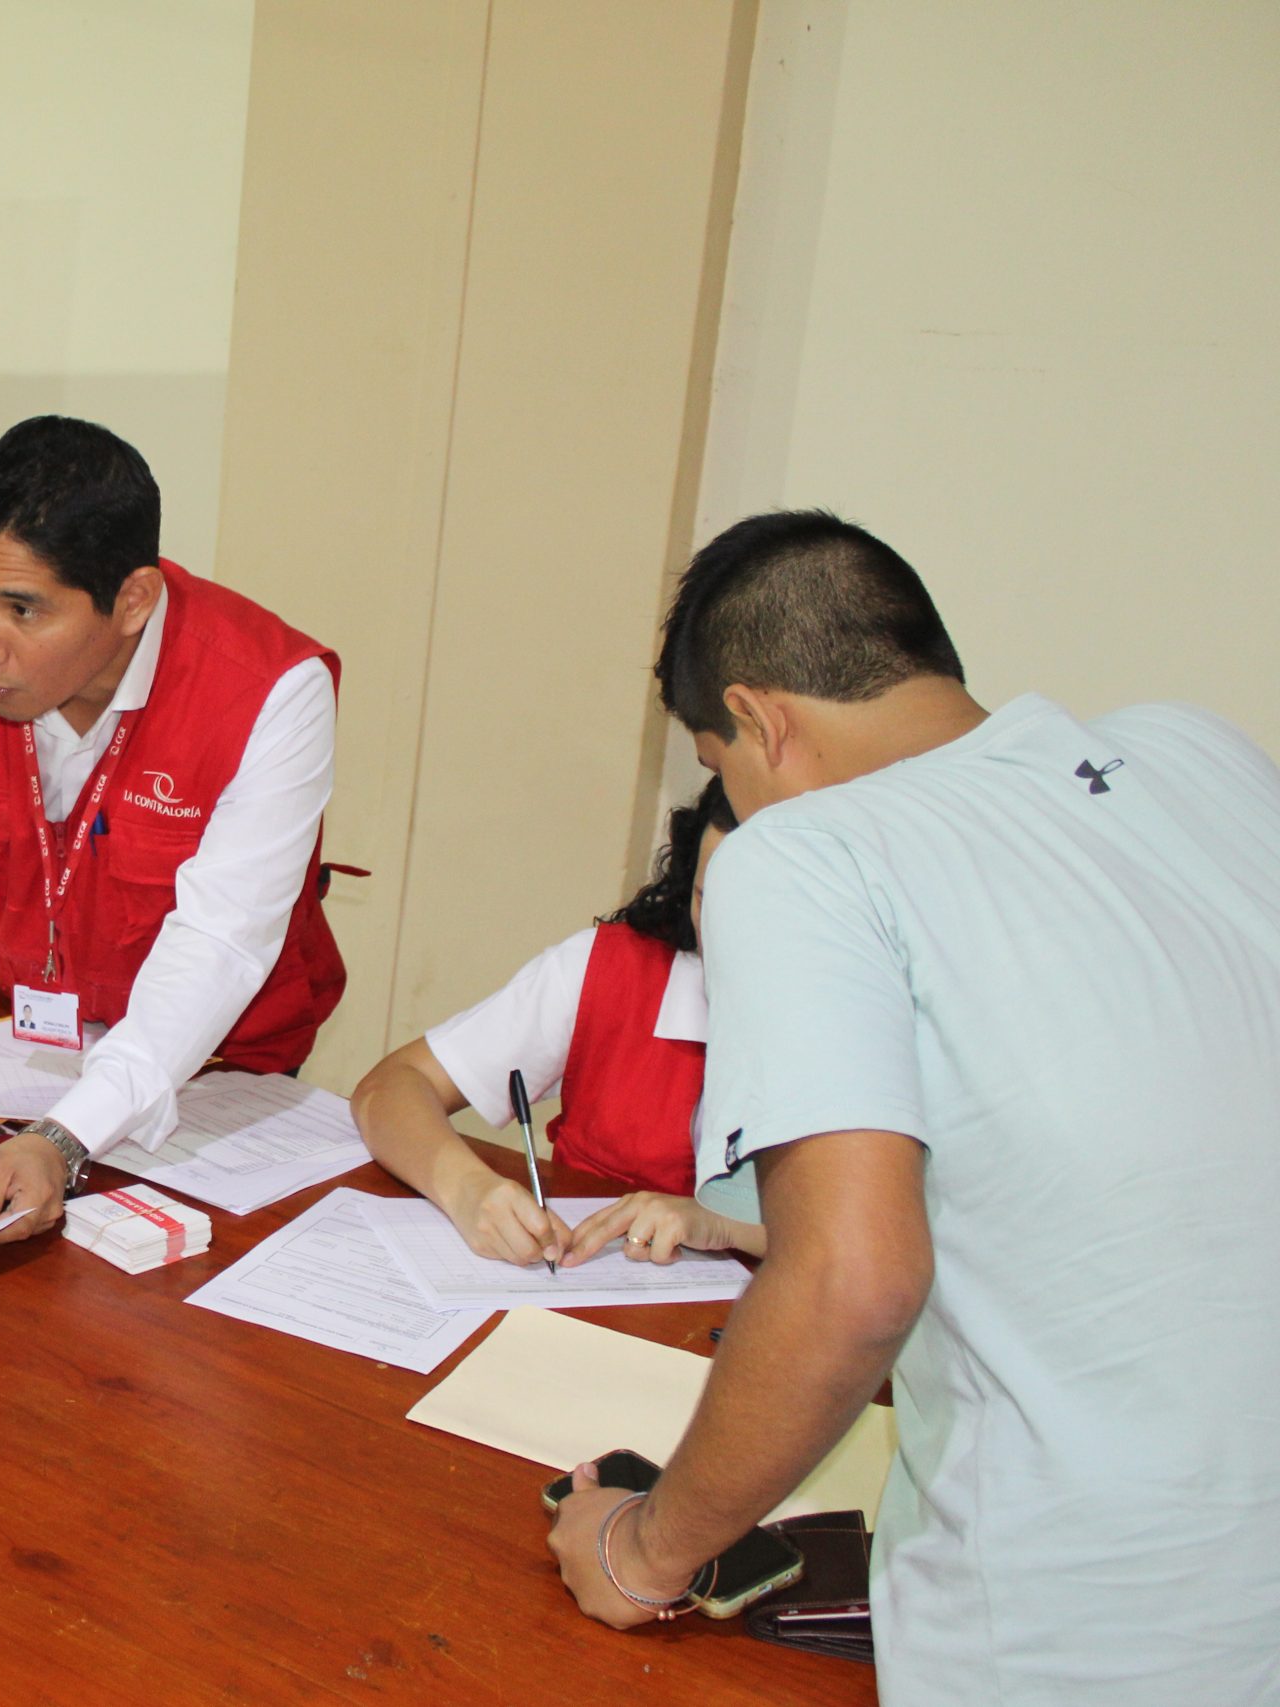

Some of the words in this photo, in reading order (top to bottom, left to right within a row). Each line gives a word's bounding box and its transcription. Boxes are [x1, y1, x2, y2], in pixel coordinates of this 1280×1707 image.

[24, 724, 32, 742] CGR
[115, 727, 126, 744] CGR
[31, 776, 39, 794] CGR
[96, 774, 107, 792] CGR
[124, 789, 132, 803] LA
[134, 794, 201, 818] CONTRALORÍA
[77, 820, 88, 838] CGR
[61, 867, 71, 885] CGR
